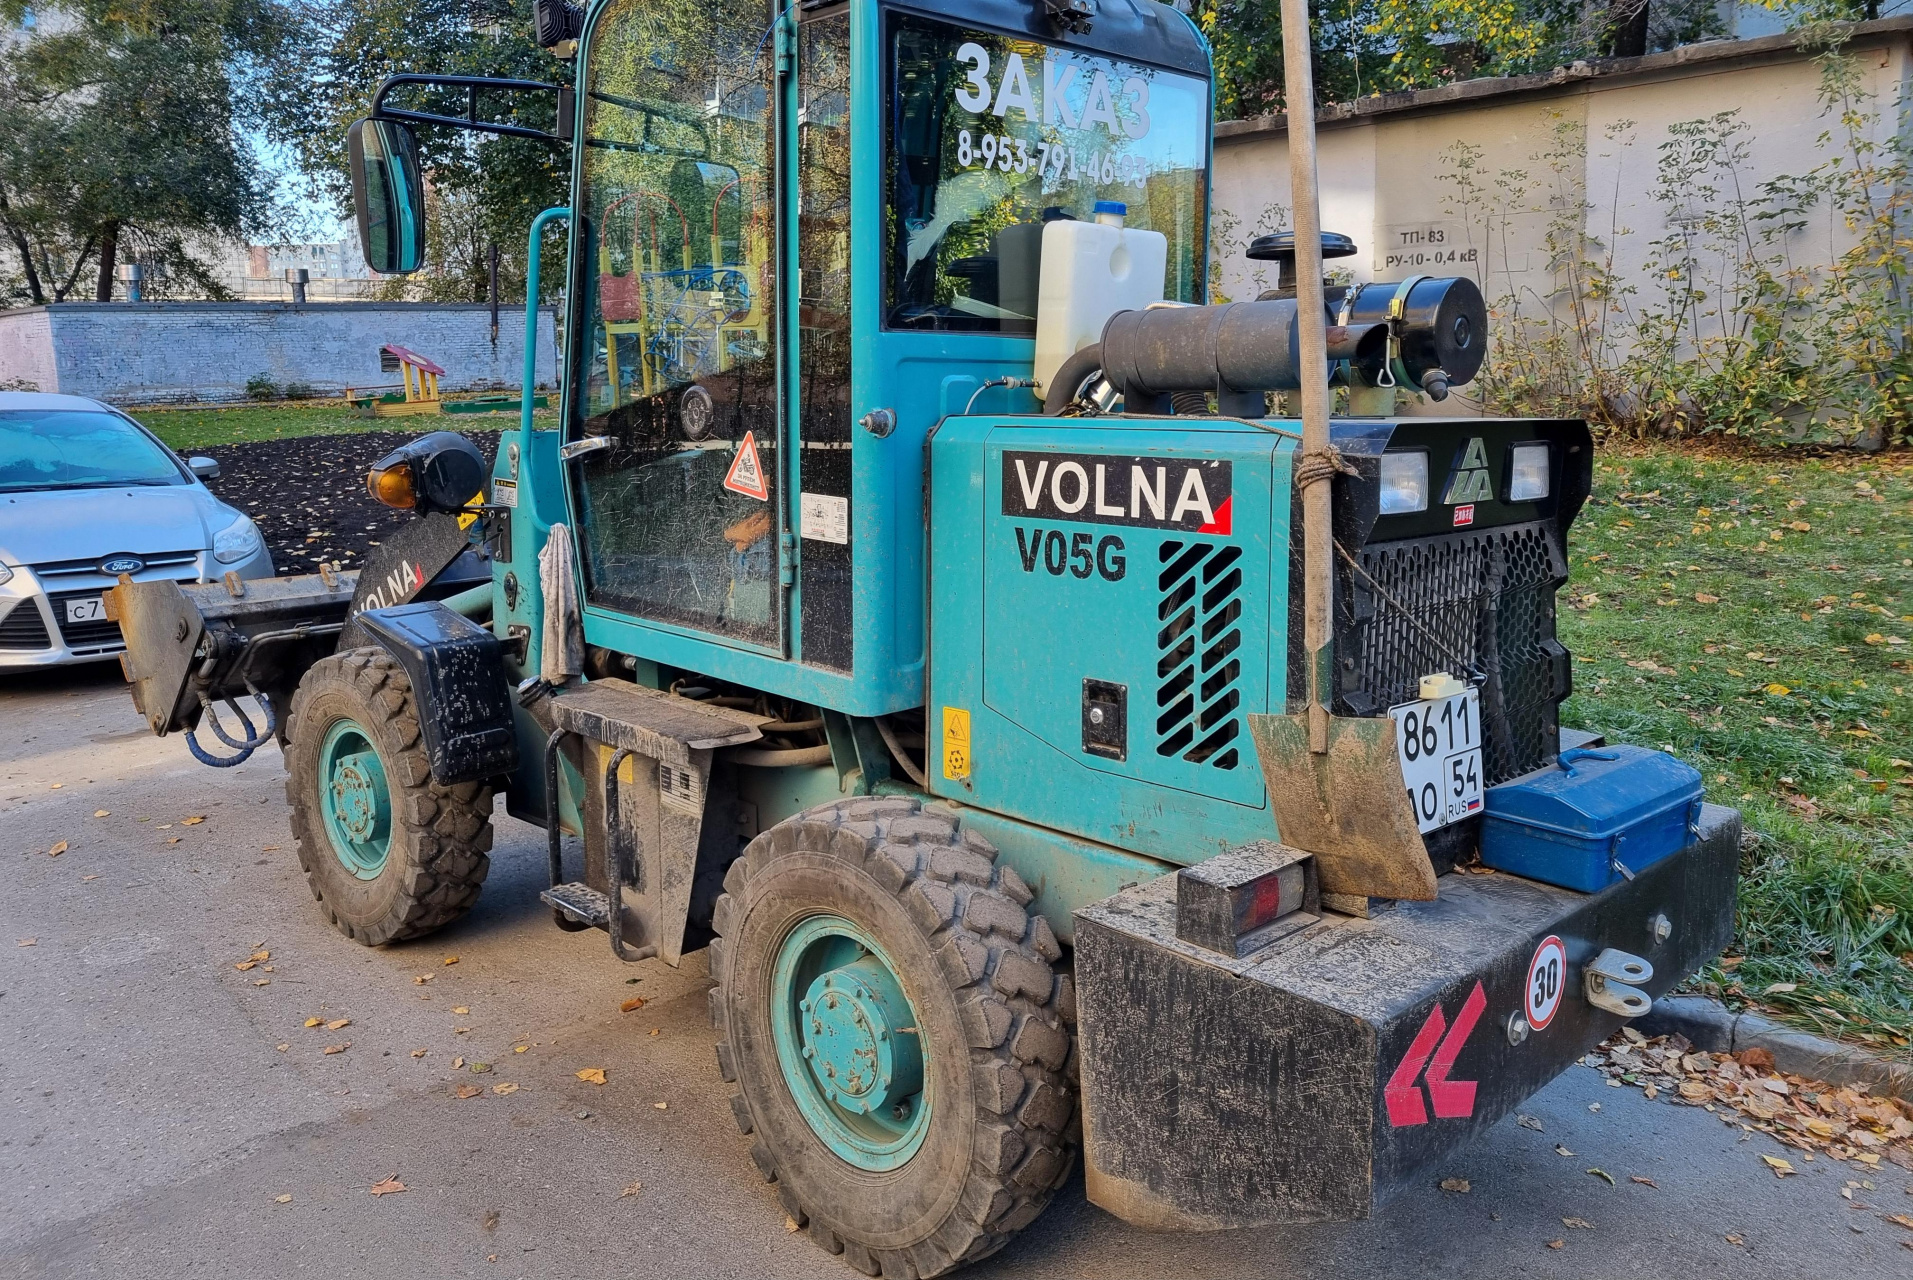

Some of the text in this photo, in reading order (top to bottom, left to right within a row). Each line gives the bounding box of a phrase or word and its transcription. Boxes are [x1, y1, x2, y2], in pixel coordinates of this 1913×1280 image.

[955, 42, 1150, 140] ЗАКАЗ
[957, 130, 1147, 189] 8-953-791-46-93
[1014, 459, 1216, 525] VOLNA
[112, 561, 134, 571] Ford
[1014, 527, 1127, 582] V05G
[353, 560, 419, 615] OLNA
[1403, 696, 1470, 762] 8611
[1452, 755, 1477, 798] 54
[1448, 803, 1467, 818] RUS
[1534, 957, 1558, 1009] 30
